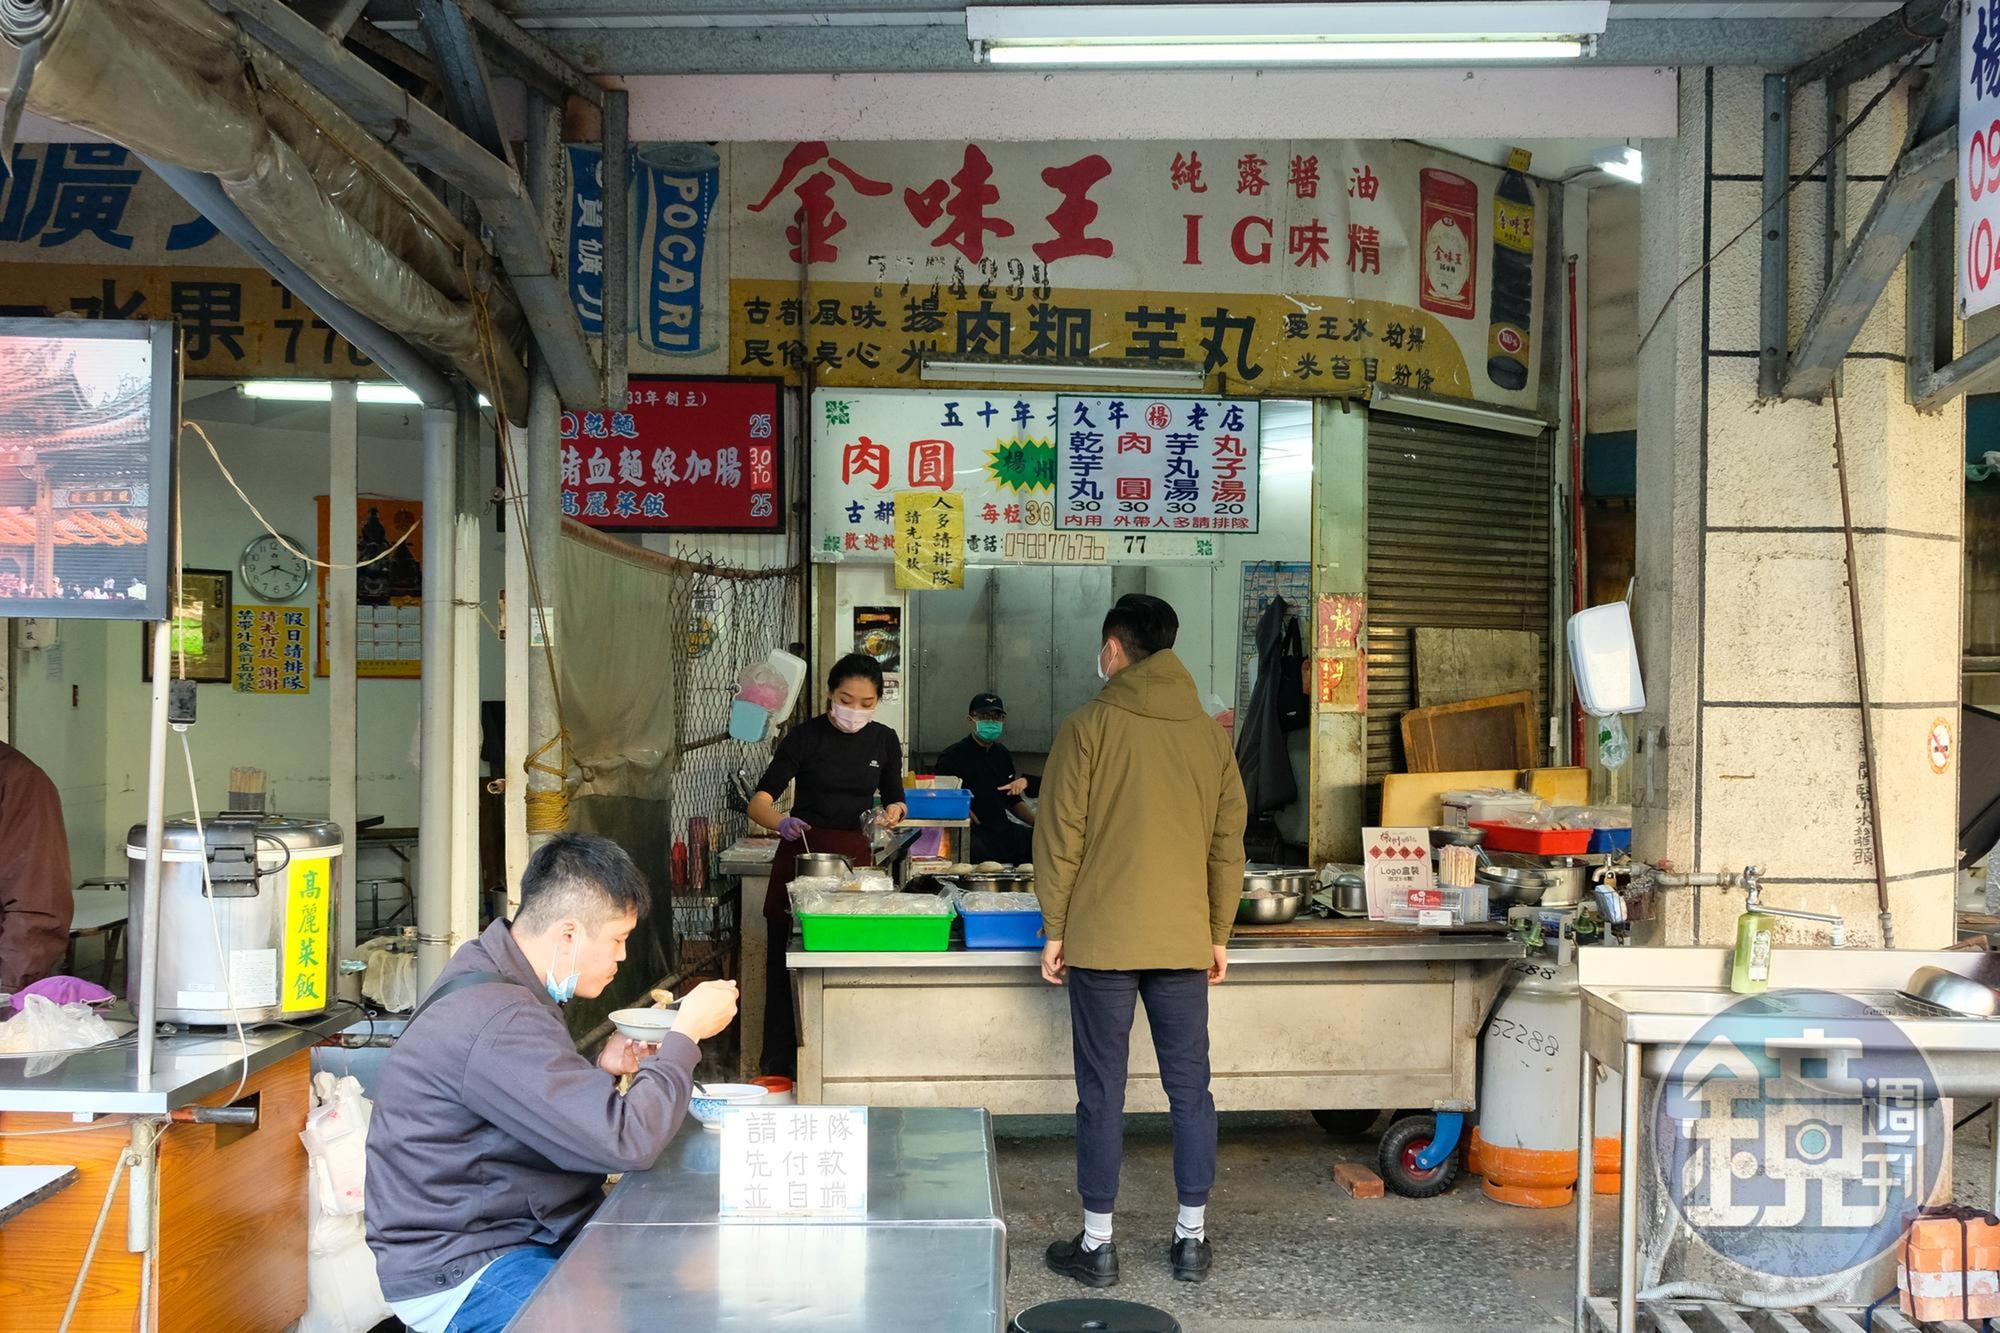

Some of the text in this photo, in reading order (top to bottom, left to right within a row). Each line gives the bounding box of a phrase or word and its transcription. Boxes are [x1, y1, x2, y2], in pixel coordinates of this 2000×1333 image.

[747, 141, 1113, 264] 金味王
[1170, 150, 1380, 202] 純露醬油
[658, 176, 700, 345] POCARI
[1433, 245, 1462, 265] 金味王
[1968, 218, 2000, 292] (0
[750, 414, 772, 438] 25
[841, 435, 955, 491] 肉圓
[1068, 431, 1103, 500] 乾芋丸
[1116, 431, 1152, 500] 肉圓
[1163, 432, 1200, 502] 芋丸湯
[1211, 434, 1247, 503] 丸子湯
[750, 493, 773, 517] 25
[981, 502, 1022, 524] 每粒
[1070, 500, 1244, 515] 30 30 30 20
[932, 497, 955, 586] 人多請排隊
[294, 869, 321, 1001] 高麗菜飯
[746, 1112, 853, 1144] 請排隊
[745, 1150, 848, 1178] 先付款
[744, 1181, 848, 1209] 並自端
